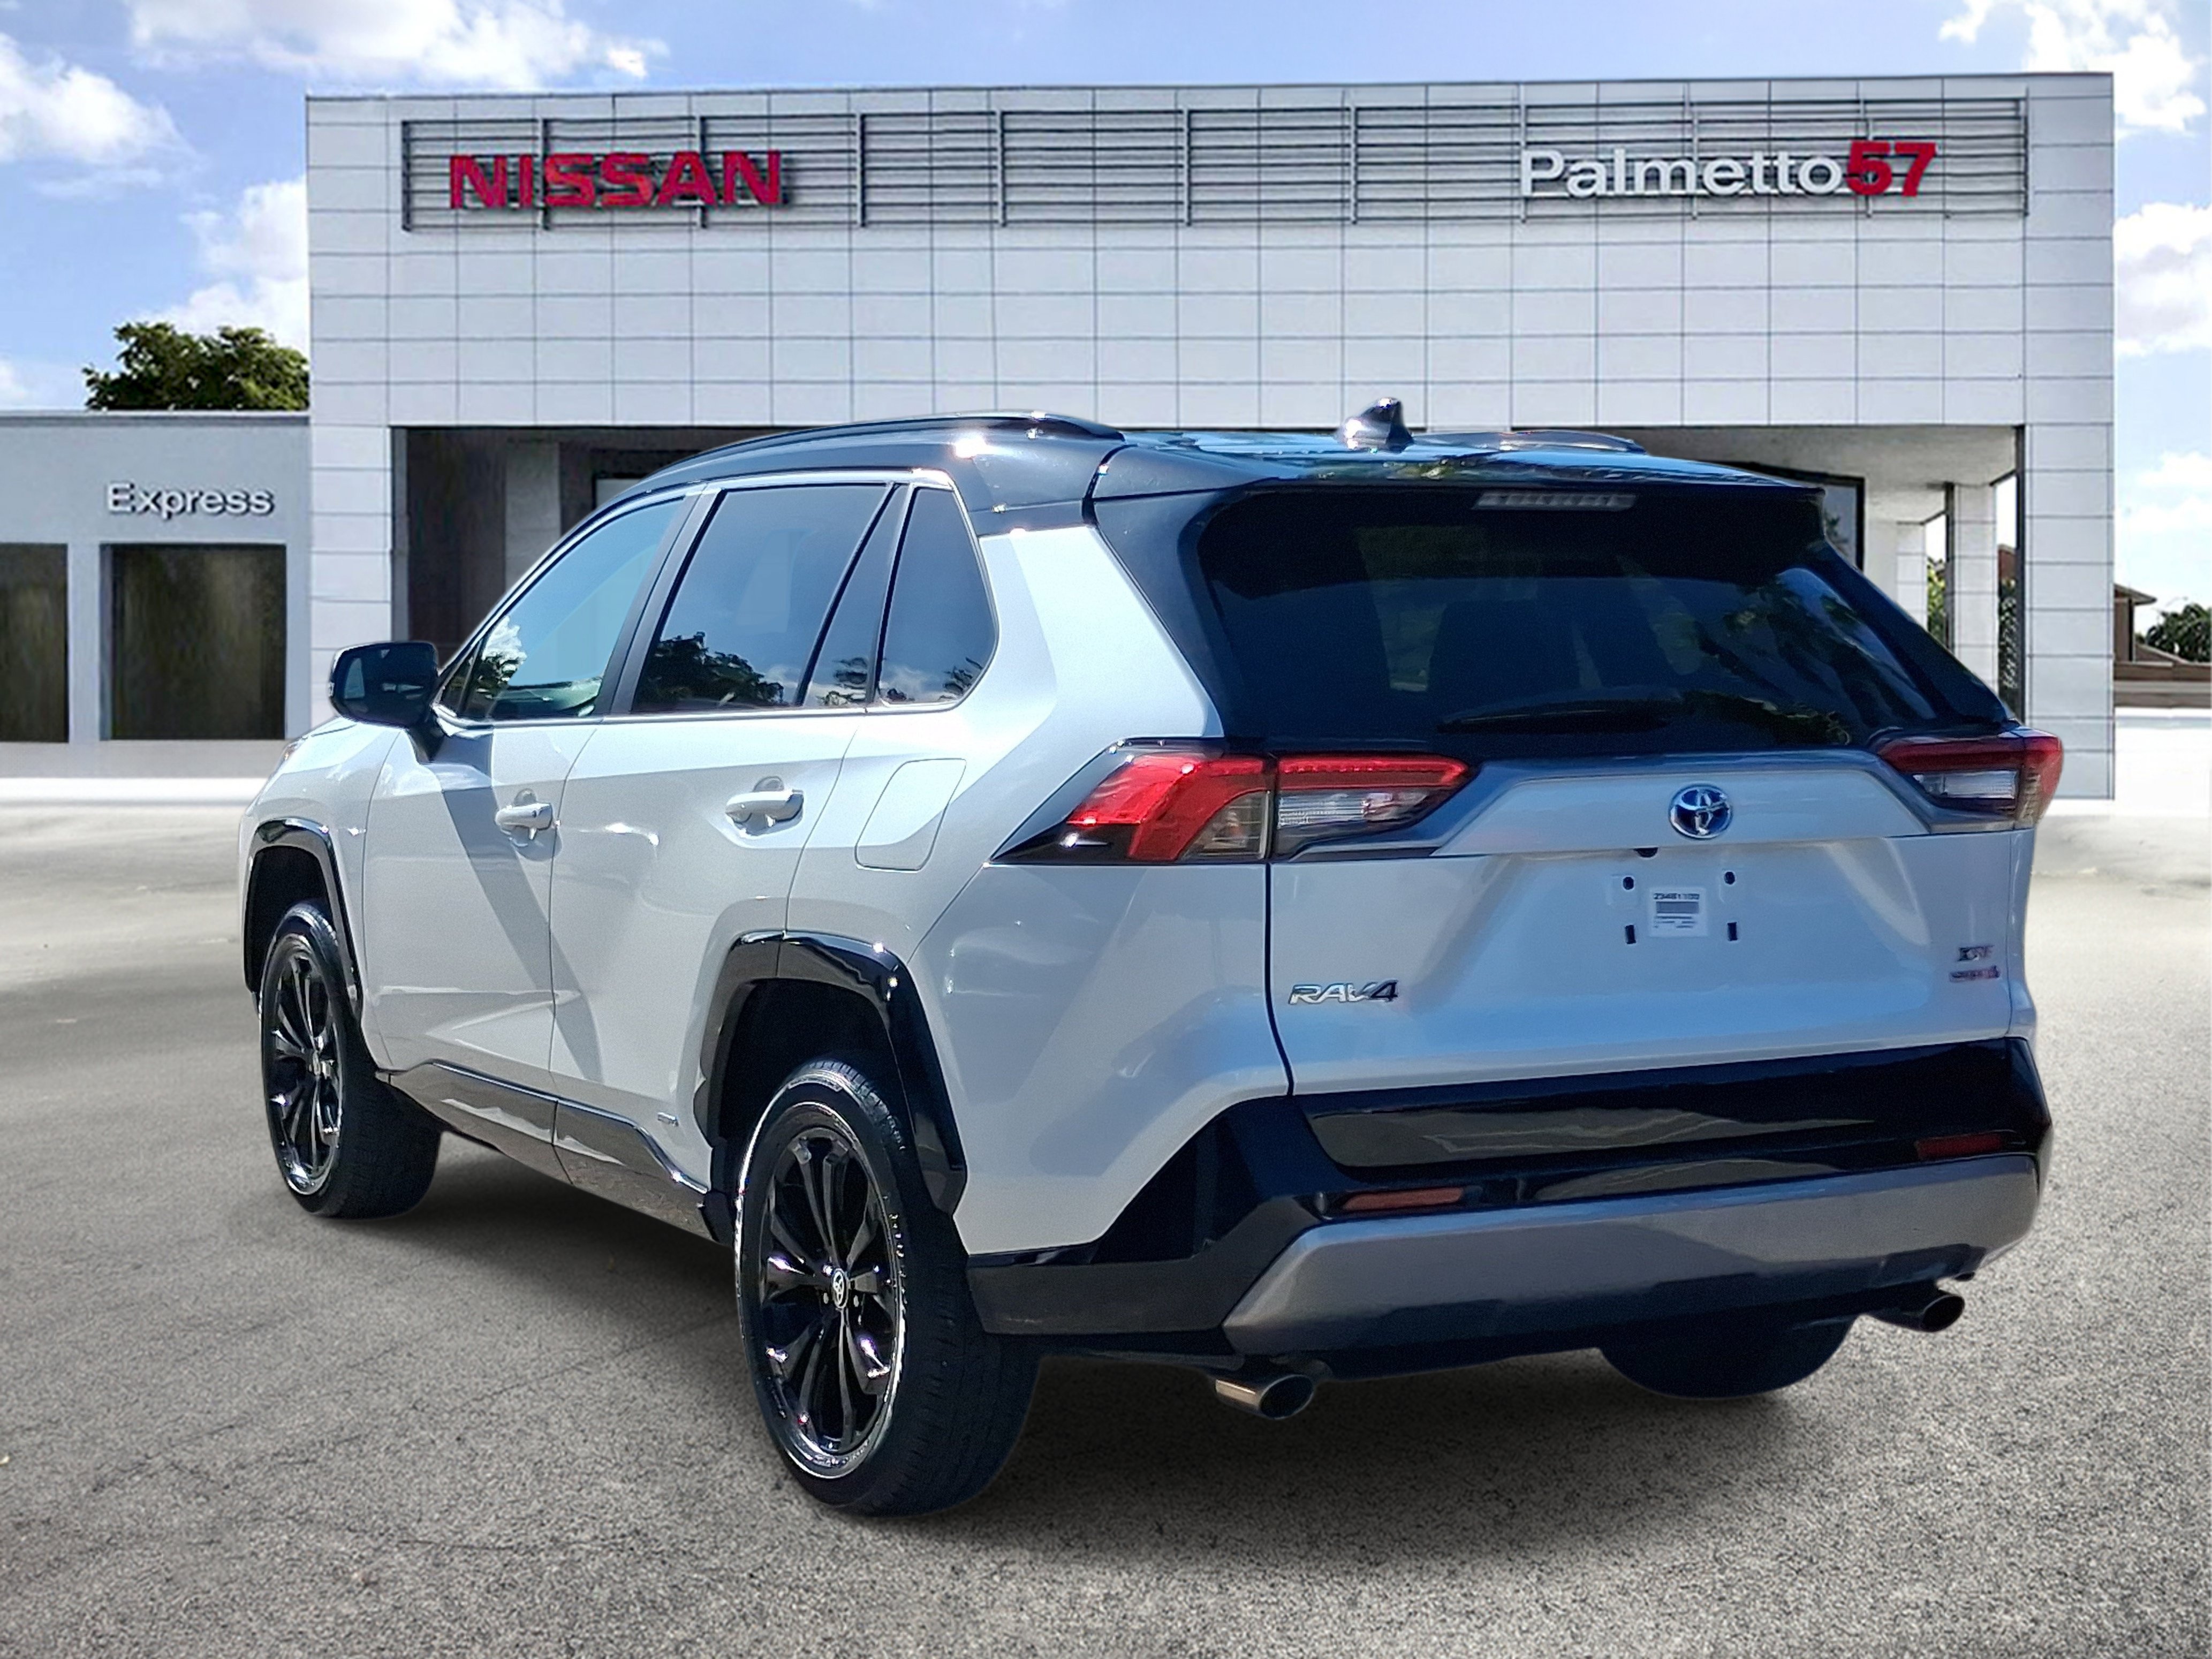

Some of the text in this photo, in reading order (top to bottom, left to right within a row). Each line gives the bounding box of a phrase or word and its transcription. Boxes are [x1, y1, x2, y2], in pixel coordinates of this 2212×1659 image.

[450, 150, 782, 209] NISSAN
[108, 482, 274, 520] Express
[1288, 978, 1398, 1005] RAV4
